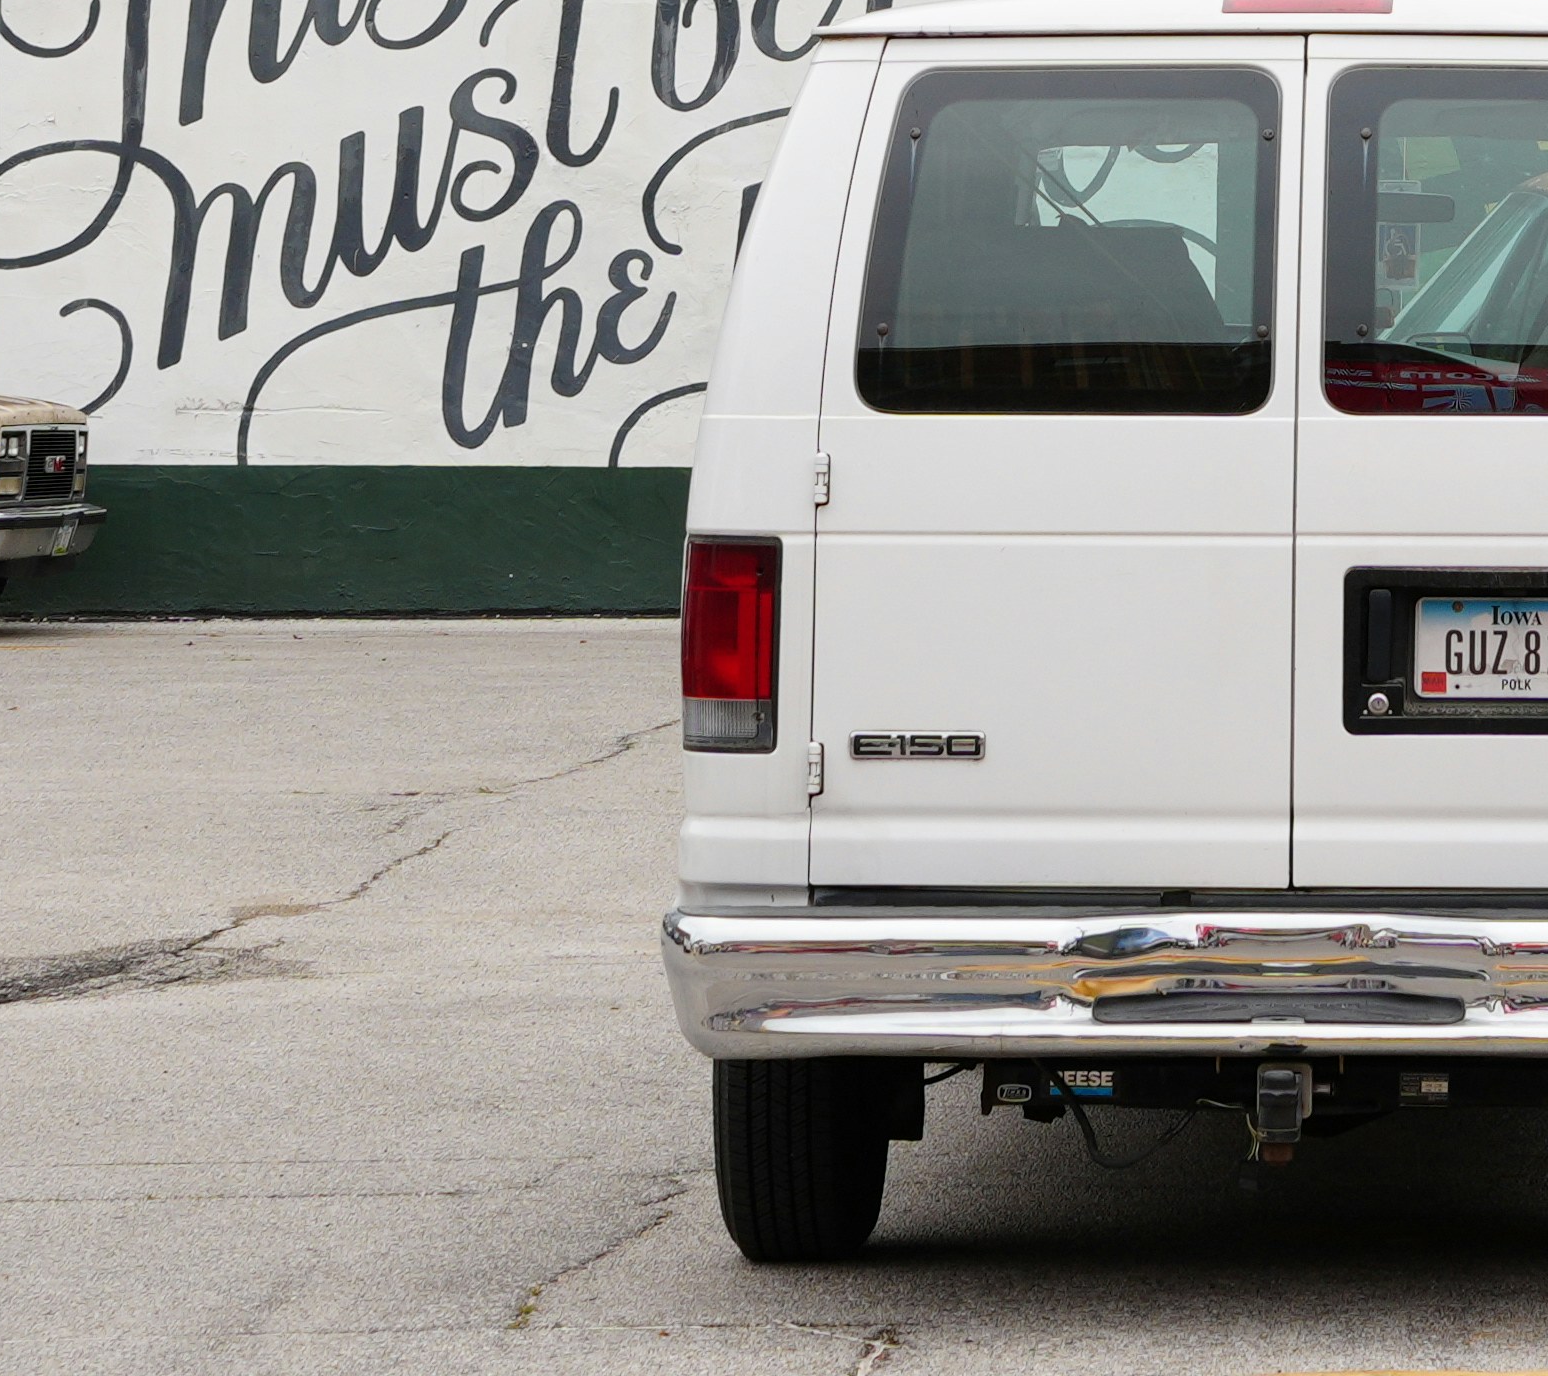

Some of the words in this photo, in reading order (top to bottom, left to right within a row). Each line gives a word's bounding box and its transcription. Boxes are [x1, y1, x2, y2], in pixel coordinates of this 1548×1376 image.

[332, 199, 677, 453] the
[1445, 629, 1508, 675] GUZ
[1501, 679, 1532, 691] POLK
[1050, 1070, 1115, 1087] EESE
